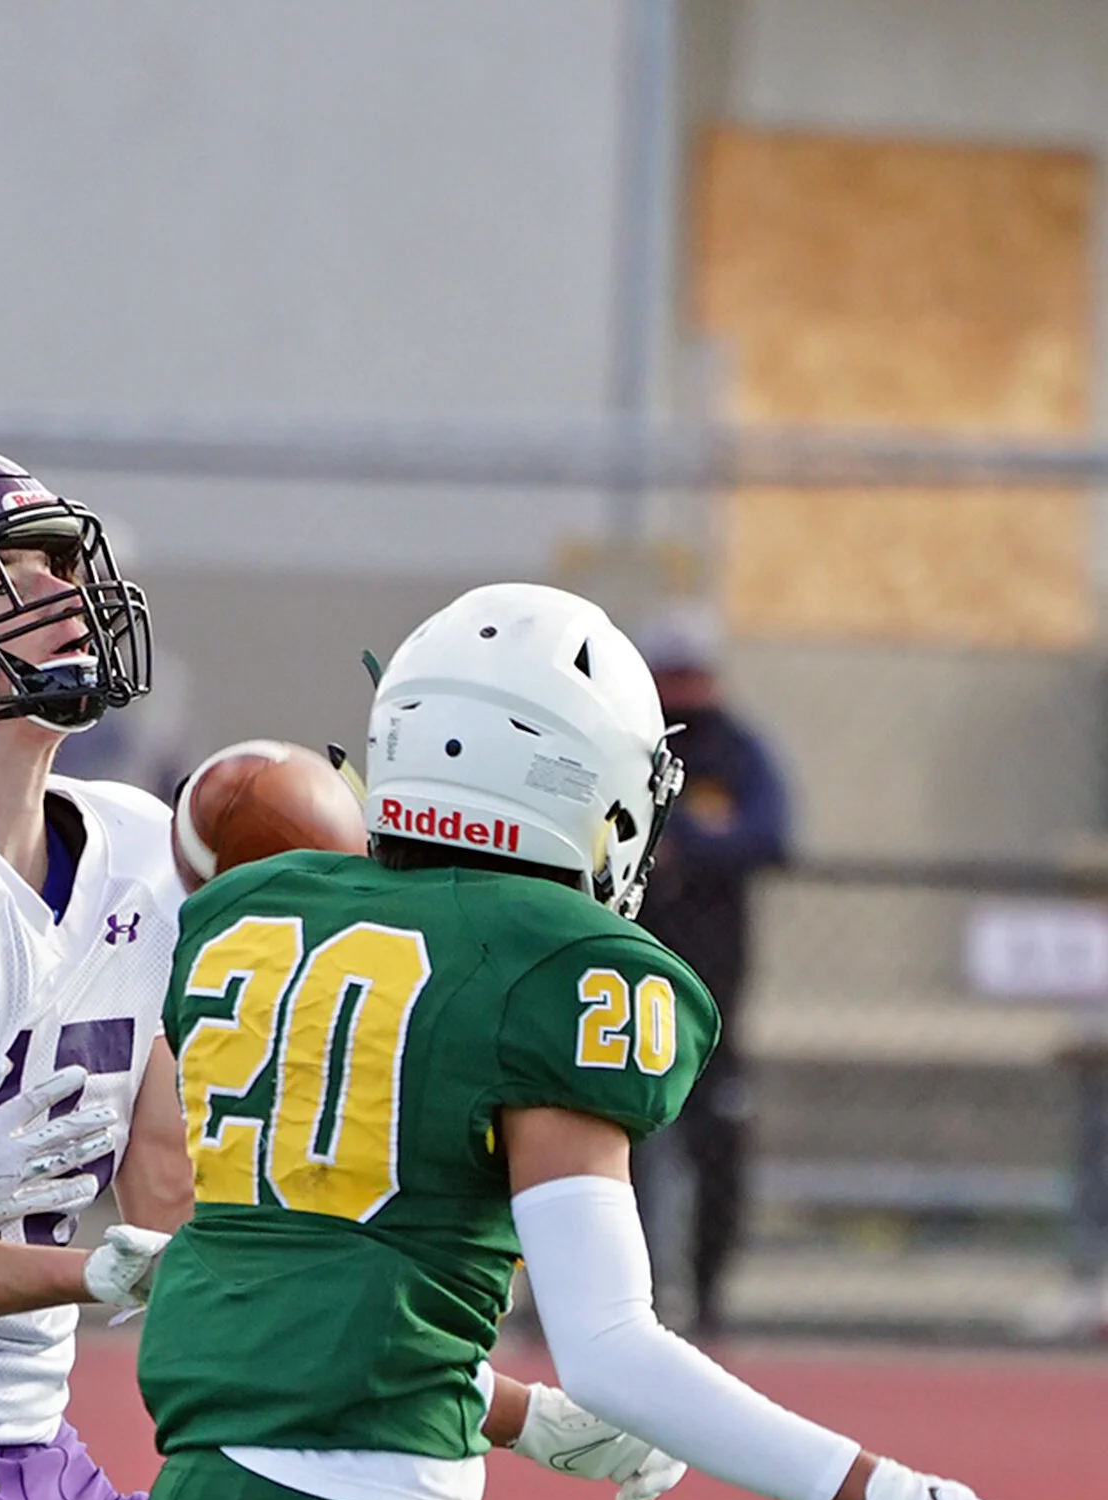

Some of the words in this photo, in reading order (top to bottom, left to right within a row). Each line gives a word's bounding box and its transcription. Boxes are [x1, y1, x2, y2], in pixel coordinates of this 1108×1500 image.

[377, 798, 520, 853] Riddell
[178, 915, 432, 1223] 20
[576, 967, 677, 1076] 20
